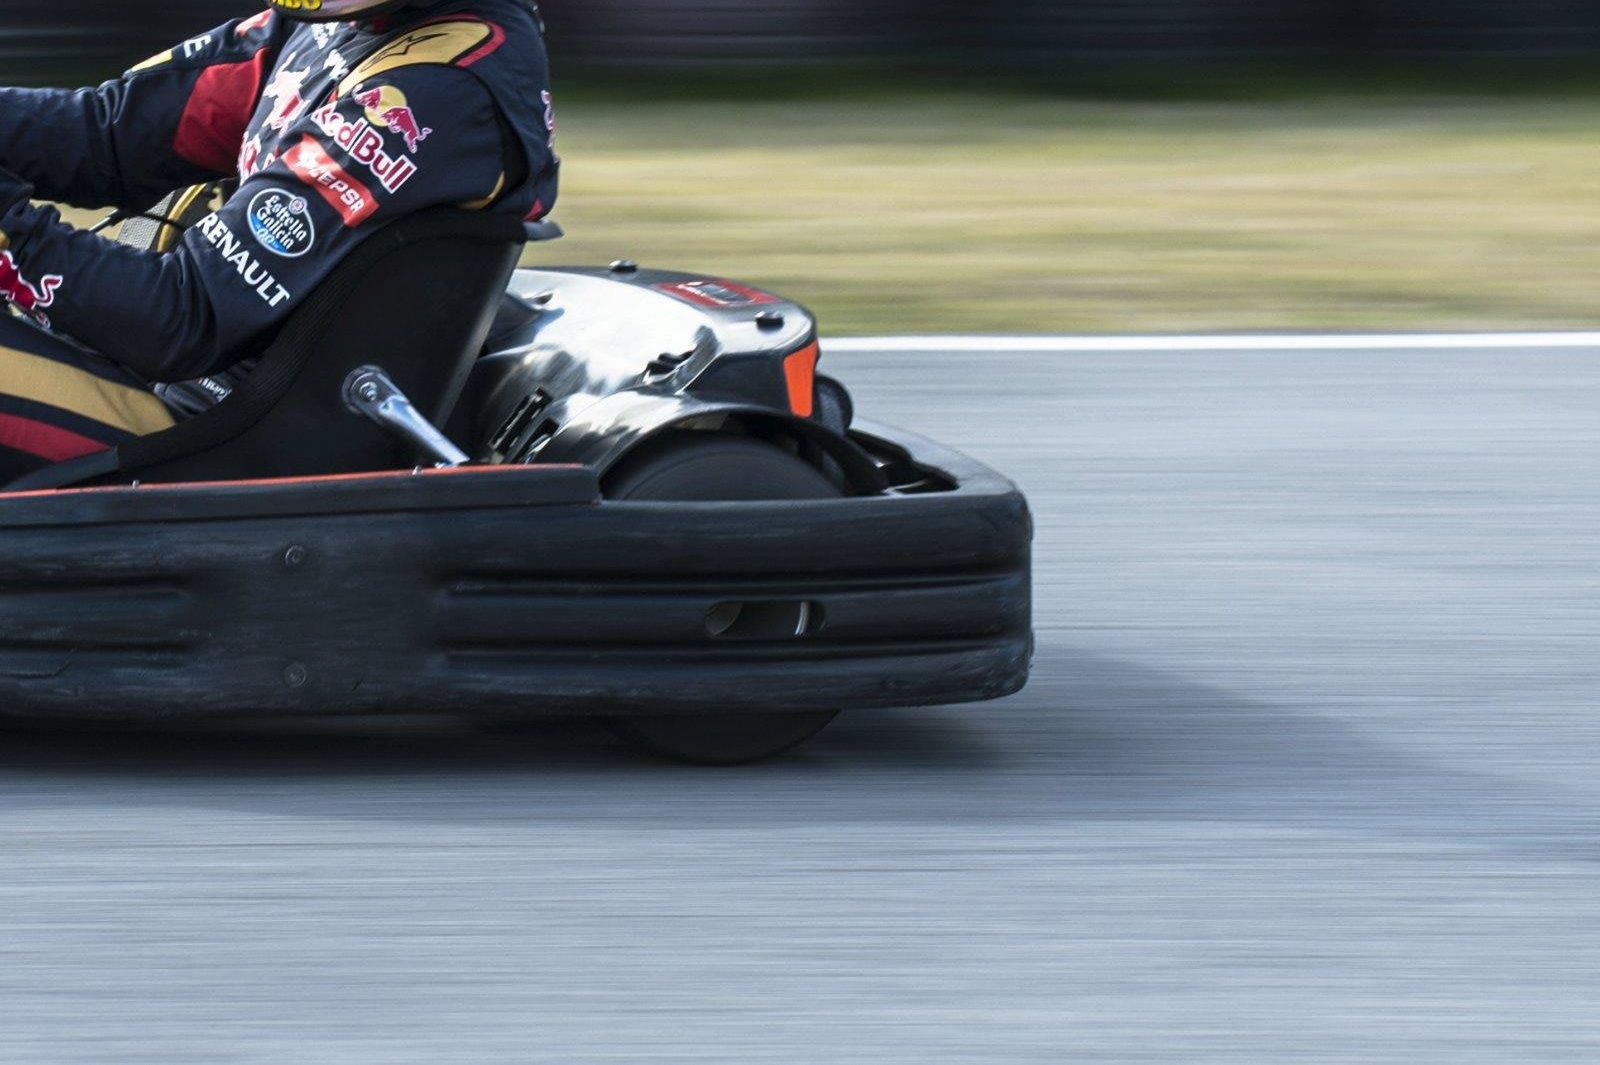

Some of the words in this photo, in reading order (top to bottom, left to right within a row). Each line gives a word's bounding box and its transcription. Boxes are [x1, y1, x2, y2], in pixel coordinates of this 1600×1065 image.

[349, 126, 418, 194] Bull
[256, 206, 295, 251] Galicia
[265, 194, 307, 242] Estrella
[195, 211, 291, 307] RENAULT
